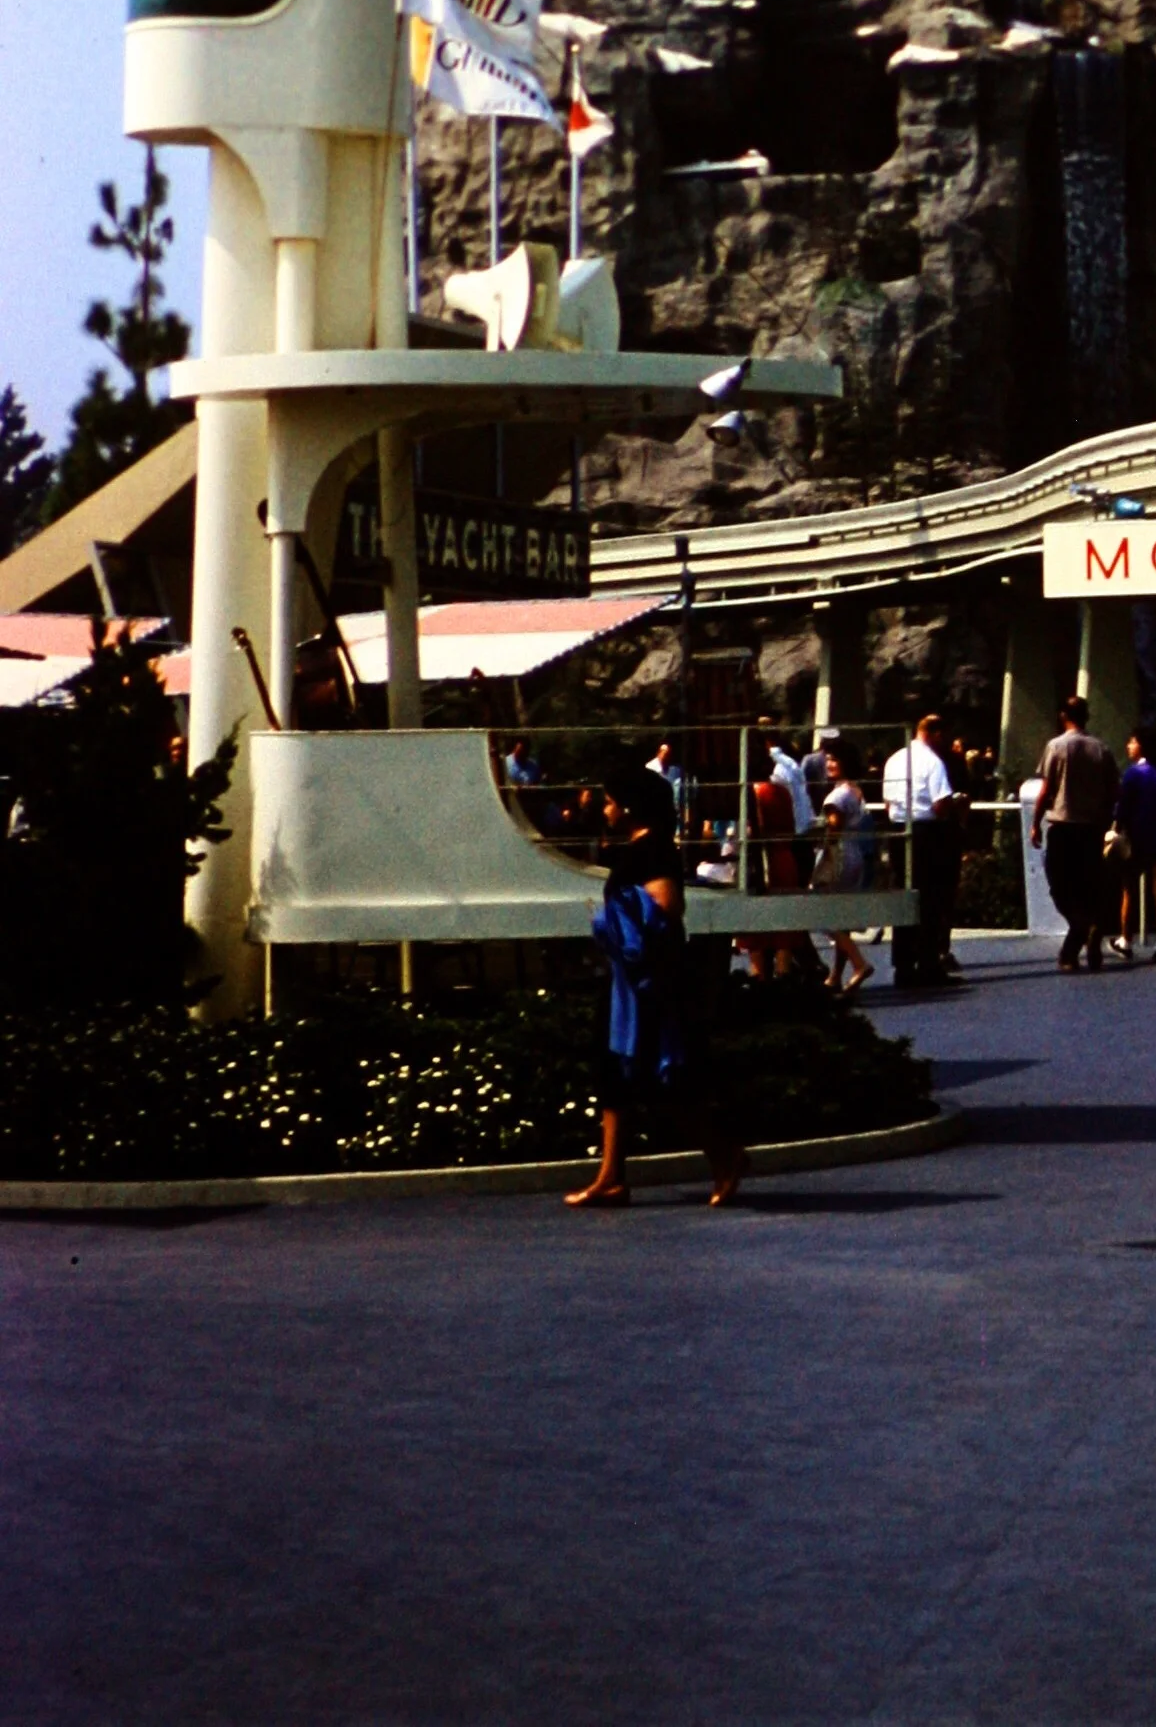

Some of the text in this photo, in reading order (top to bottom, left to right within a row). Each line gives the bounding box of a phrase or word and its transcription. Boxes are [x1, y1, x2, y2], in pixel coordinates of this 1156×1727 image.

[349, 502, 579, 582] TH YACHT BAR
